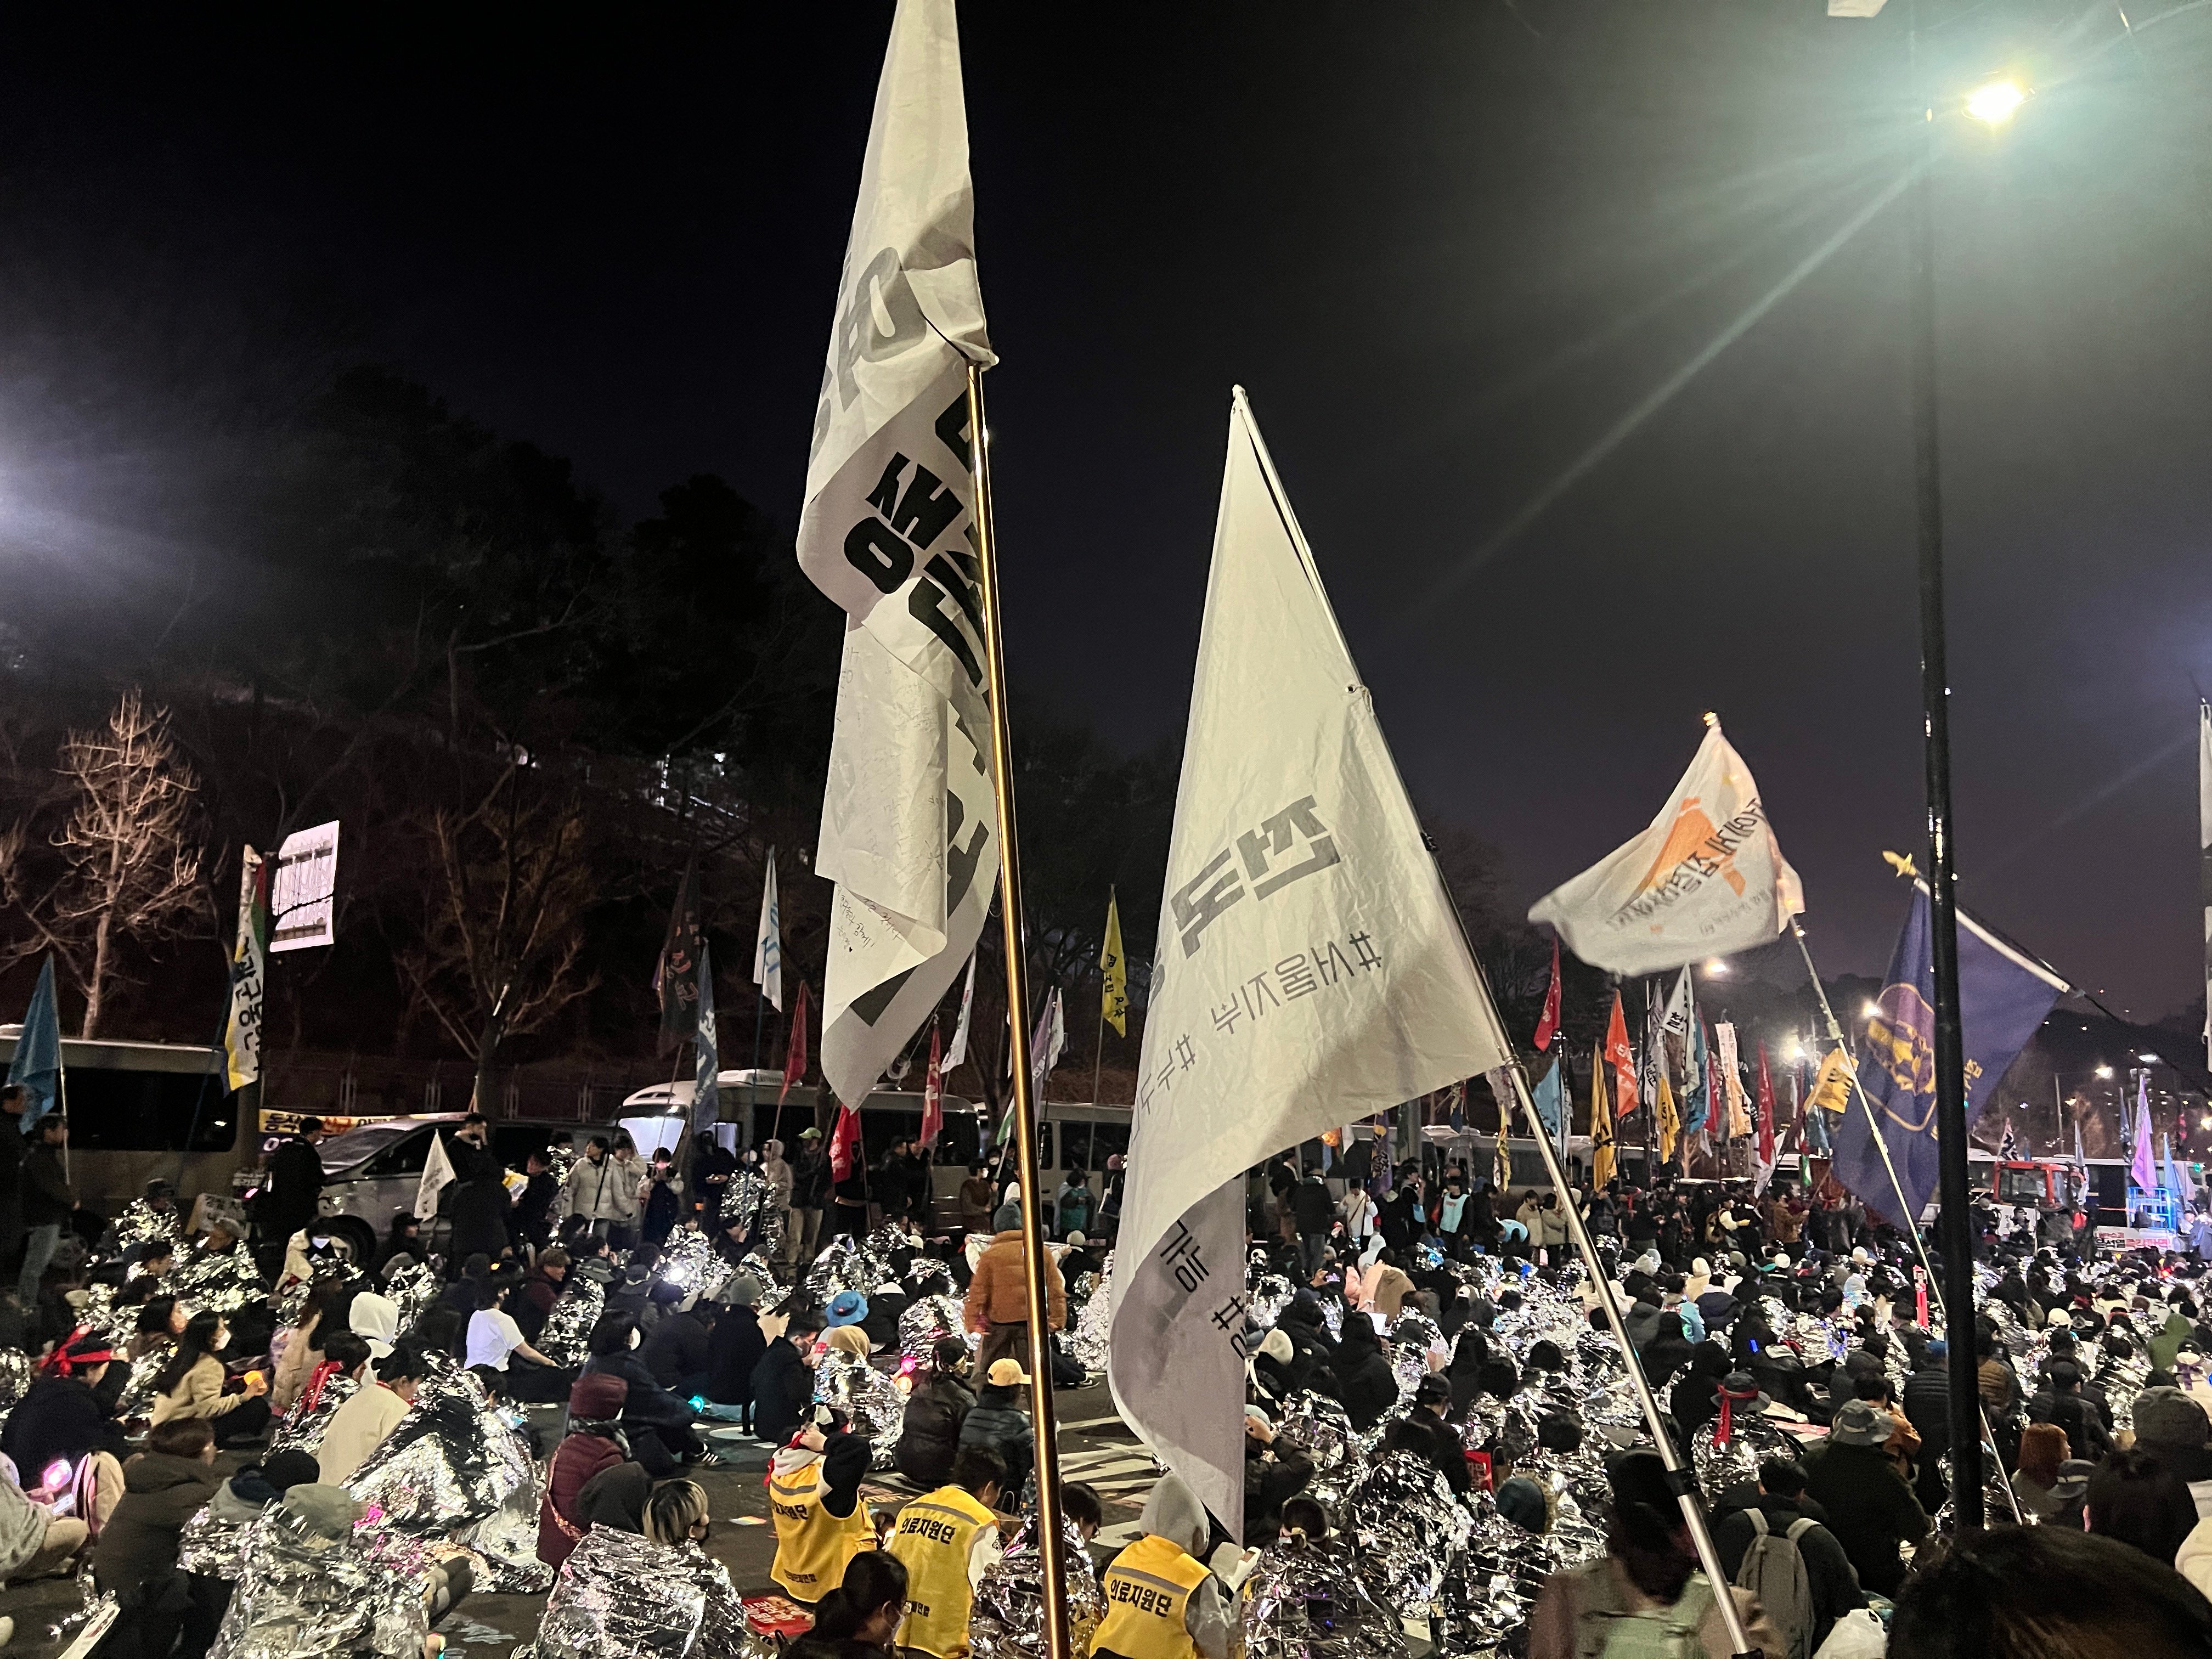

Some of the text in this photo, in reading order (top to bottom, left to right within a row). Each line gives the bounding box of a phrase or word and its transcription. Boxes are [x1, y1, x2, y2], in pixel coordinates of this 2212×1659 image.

[1160, 1219, 1210, 1294] 가능
[899, 1517, 956, 1545] 의료지원단
[1110, 1578, 1173, 1618] 의료지원단
